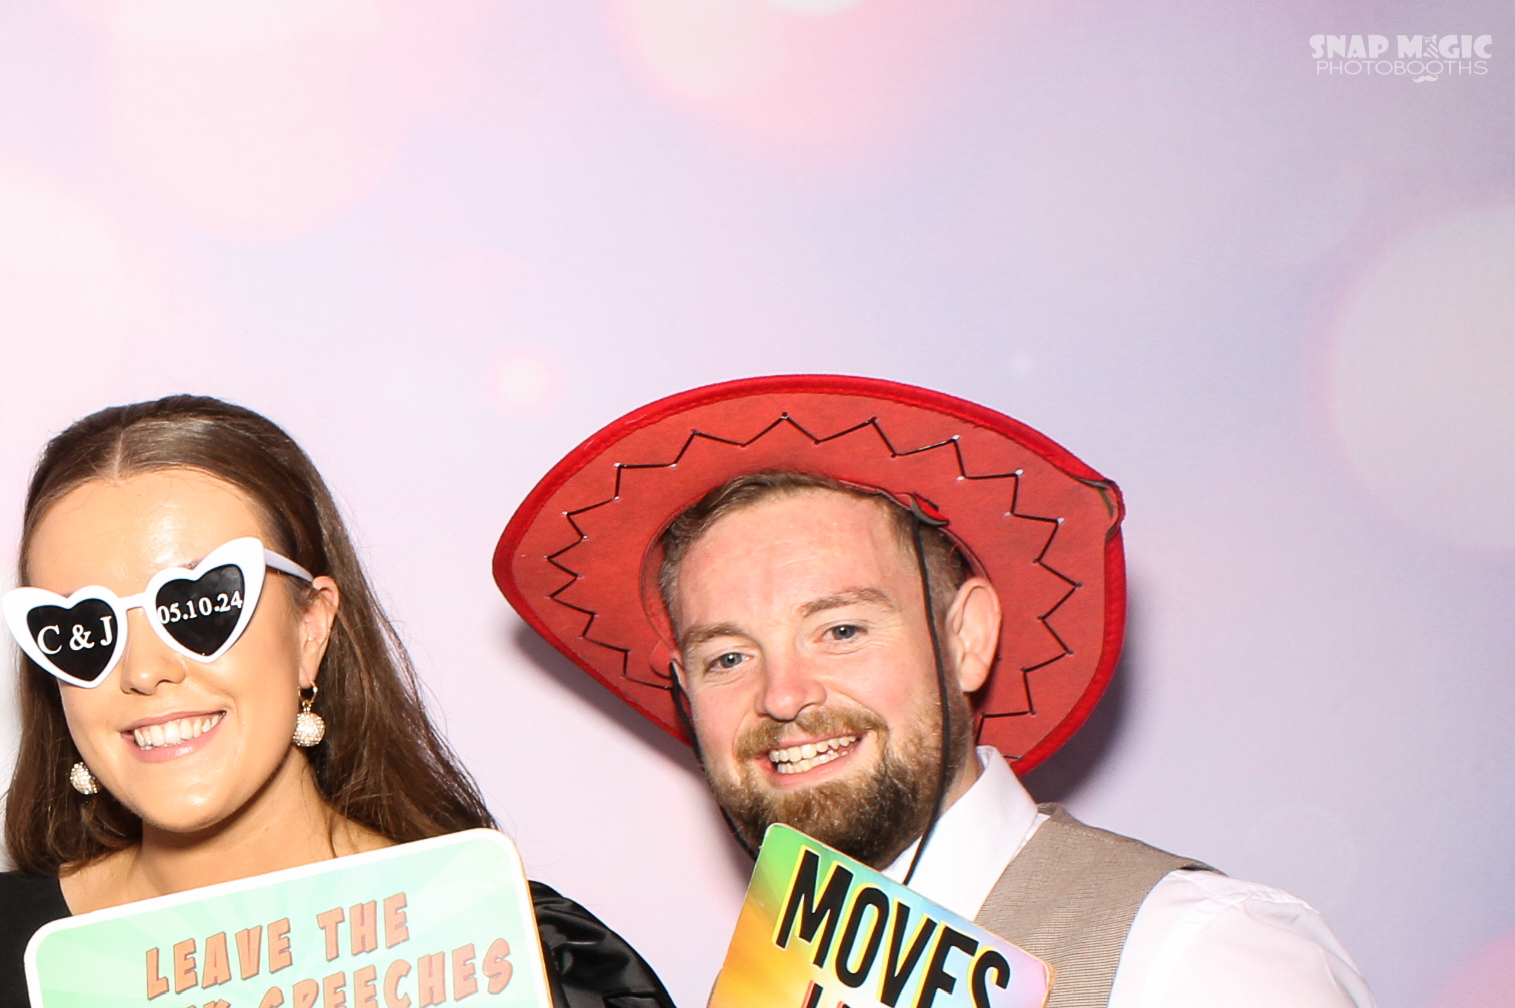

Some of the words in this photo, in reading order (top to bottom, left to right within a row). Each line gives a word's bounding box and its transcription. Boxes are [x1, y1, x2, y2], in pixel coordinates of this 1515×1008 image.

[157, 590, 244, 625] 05.10.24
[37, 624, 63, 655] C
[69, 623, 95, 651] &
[99, 615, 115, 646] J
[145, 917, 293, 1000] LEAVE
[316, 891, 410, 961] THE
